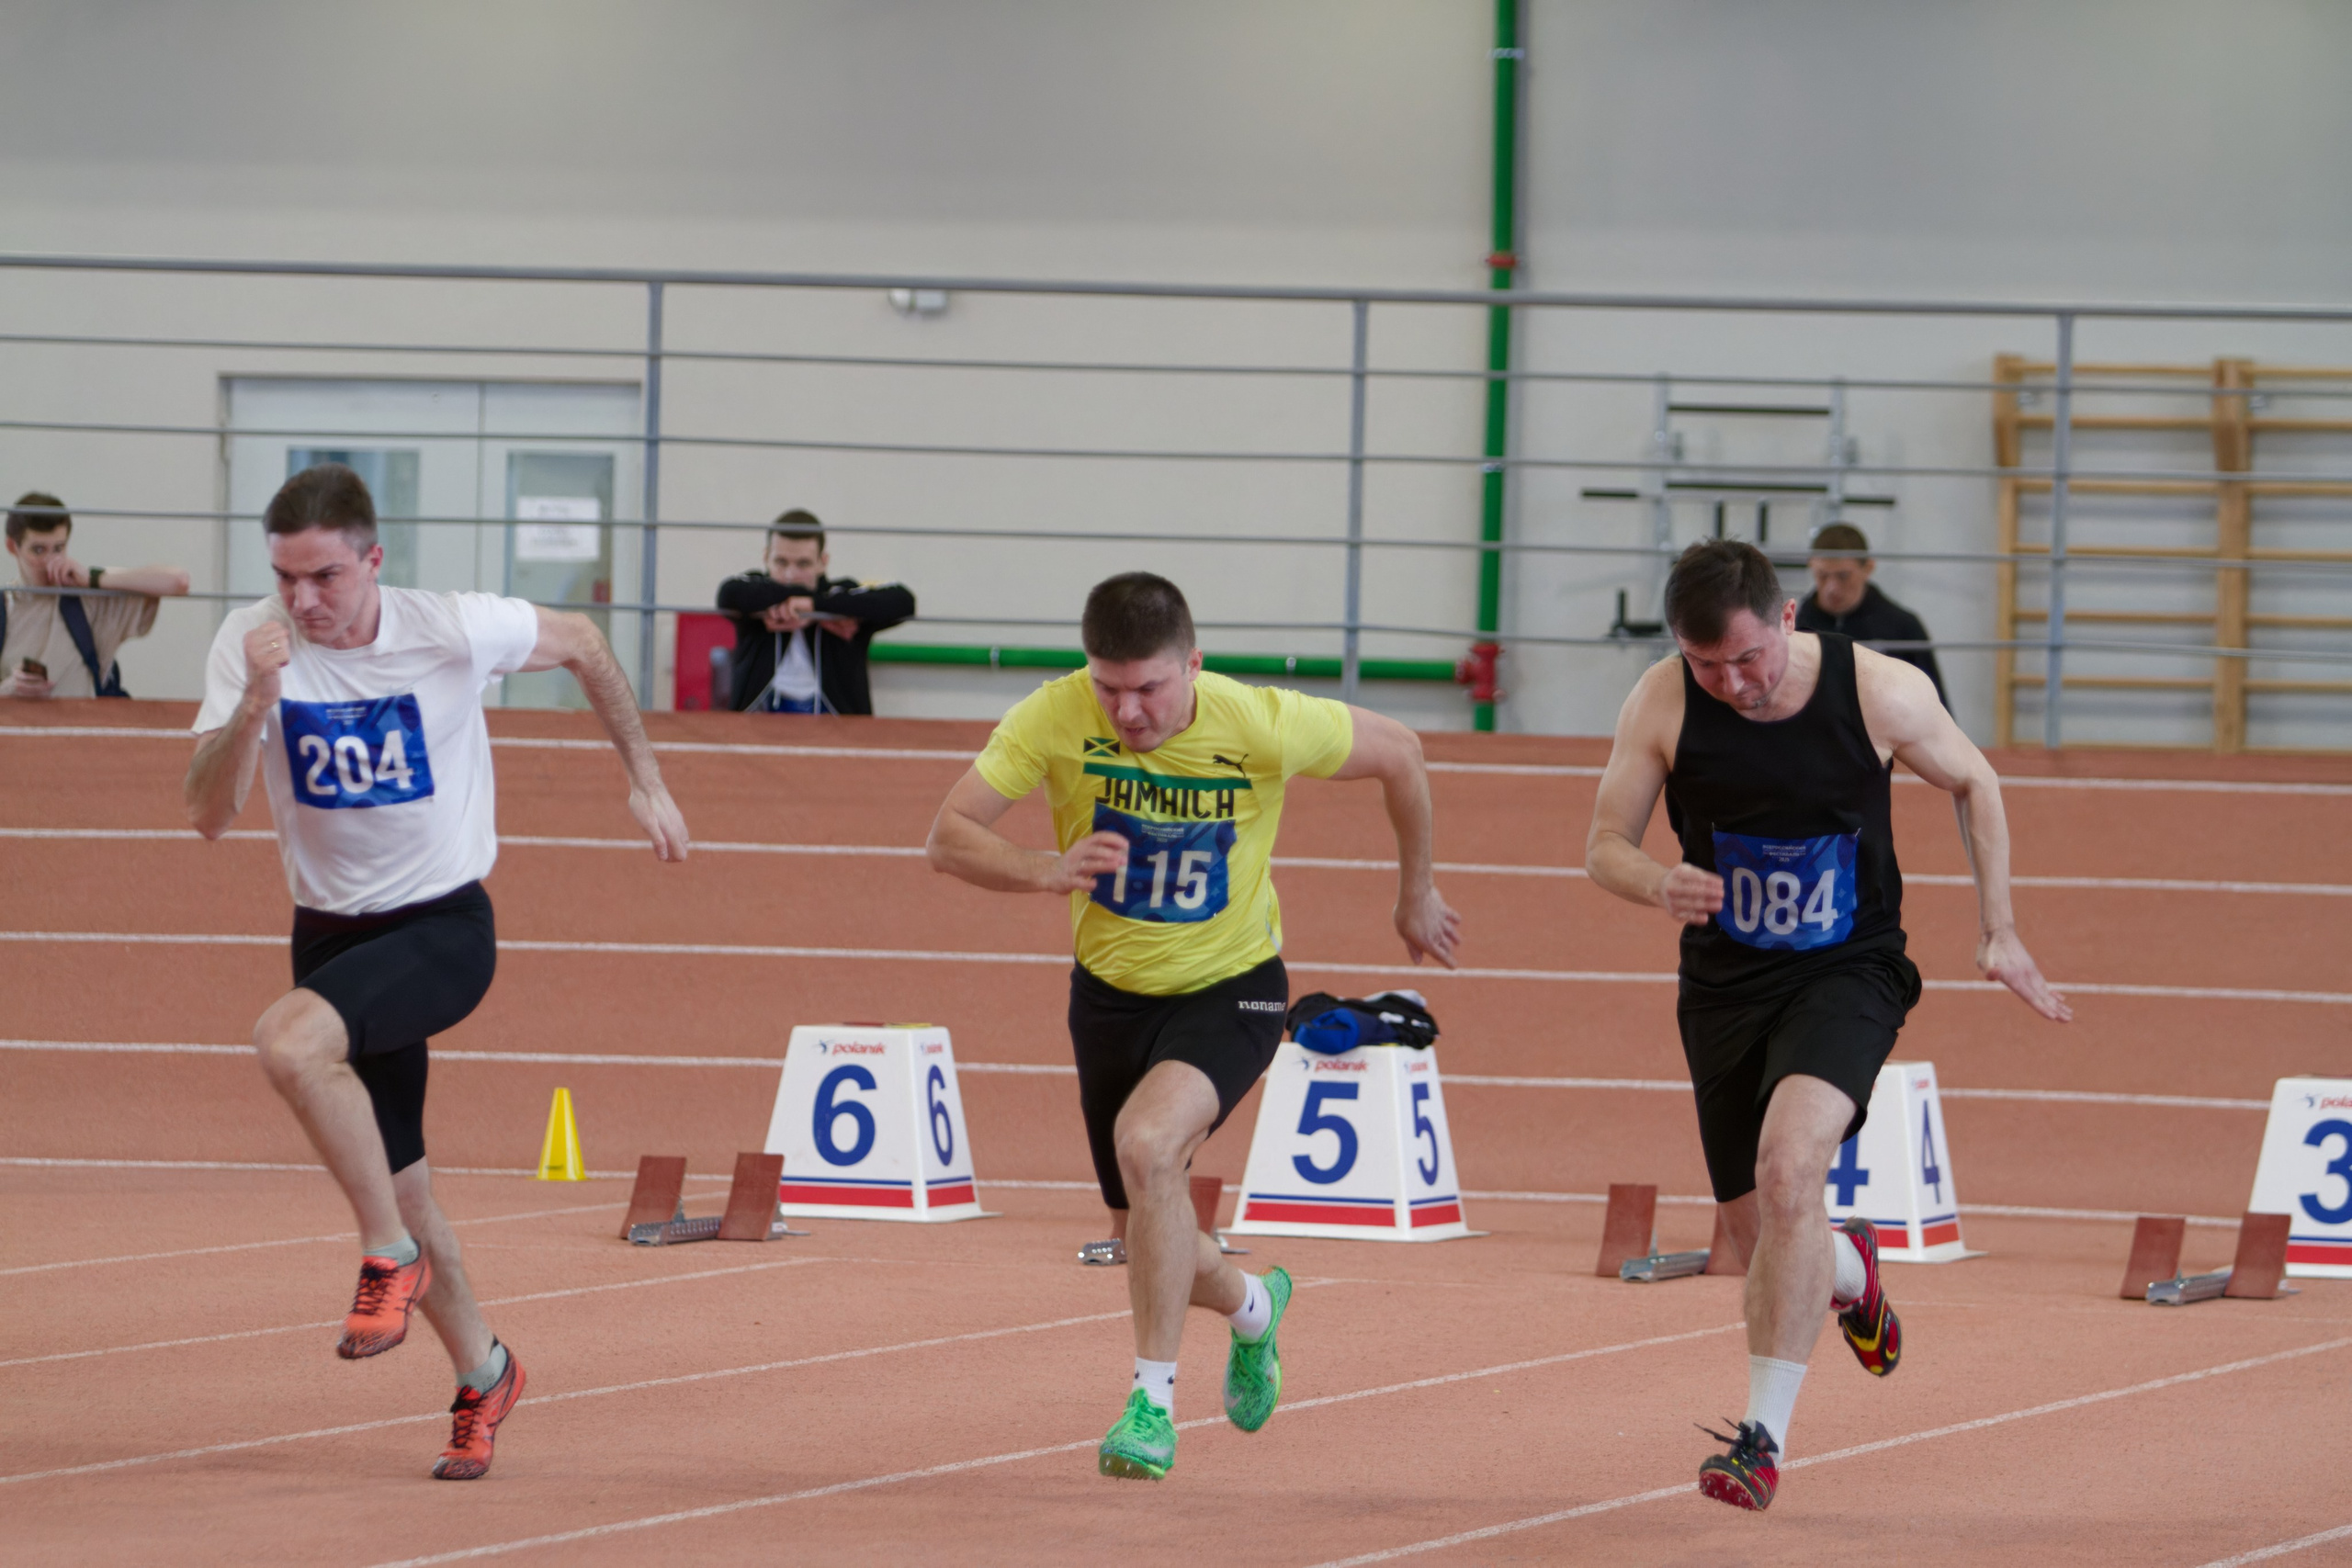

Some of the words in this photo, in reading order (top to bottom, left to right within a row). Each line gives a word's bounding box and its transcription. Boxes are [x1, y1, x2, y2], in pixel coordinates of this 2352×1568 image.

[299, 729, 413, 795] 204
[1095, 776, 1235, 819] JAMAICA
[1113, 850, 1212, 909] 115
[1732, 867, 1838, 935] 084
[831, 1042, 886, 1055] polanik
[1314, 1057, 1368, 1072] polanik
[813, 1064, 876, 1167] 6
[927, 1065, 953, 1167] 6
[1292, 1080, 1359, 1185] 5
[1411, 1082, 1439, 1186] 5
[1921, 1100, 1940, 1204] 4
[2300, 1119, 2352, 1224] 3
